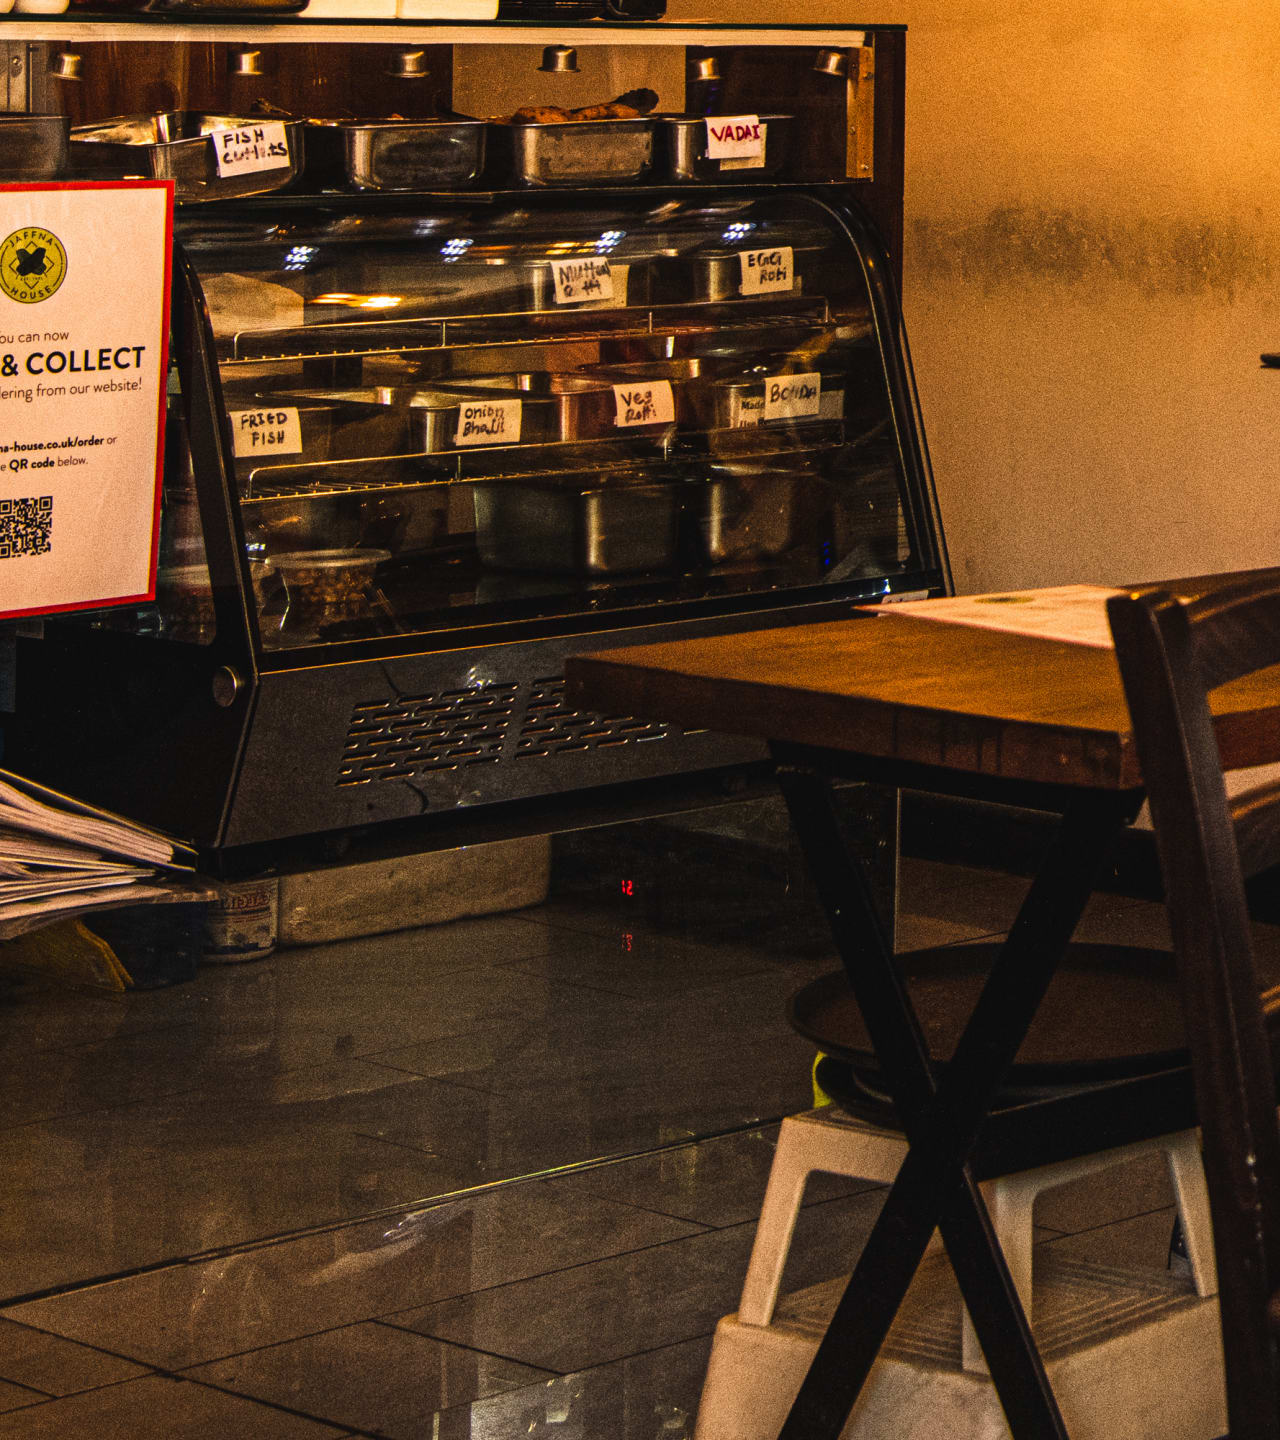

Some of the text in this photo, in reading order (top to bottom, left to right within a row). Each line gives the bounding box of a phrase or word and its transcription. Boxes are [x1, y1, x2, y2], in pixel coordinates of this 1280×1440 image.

[222, 128, 264, 149] FISH
[710, 124, 761, 142] VADAI
[9, 230, 54, 248] JAFFNA
[10, 285, 52, 300] HOUSE
[0, 330, 70, 345] ou can now
[1, 345, 147, 377] & COLLECT
[0, 376, 143, 404] ering from our website!
[240, 411, 288, 430] FRIED
[106, 435, 118, 445] or
[251, 430, 286, 447] FISH
[9, 458, 29, 473] QR
[31, 456, 55, 469] code
[57, 455, 89, 467] below.
